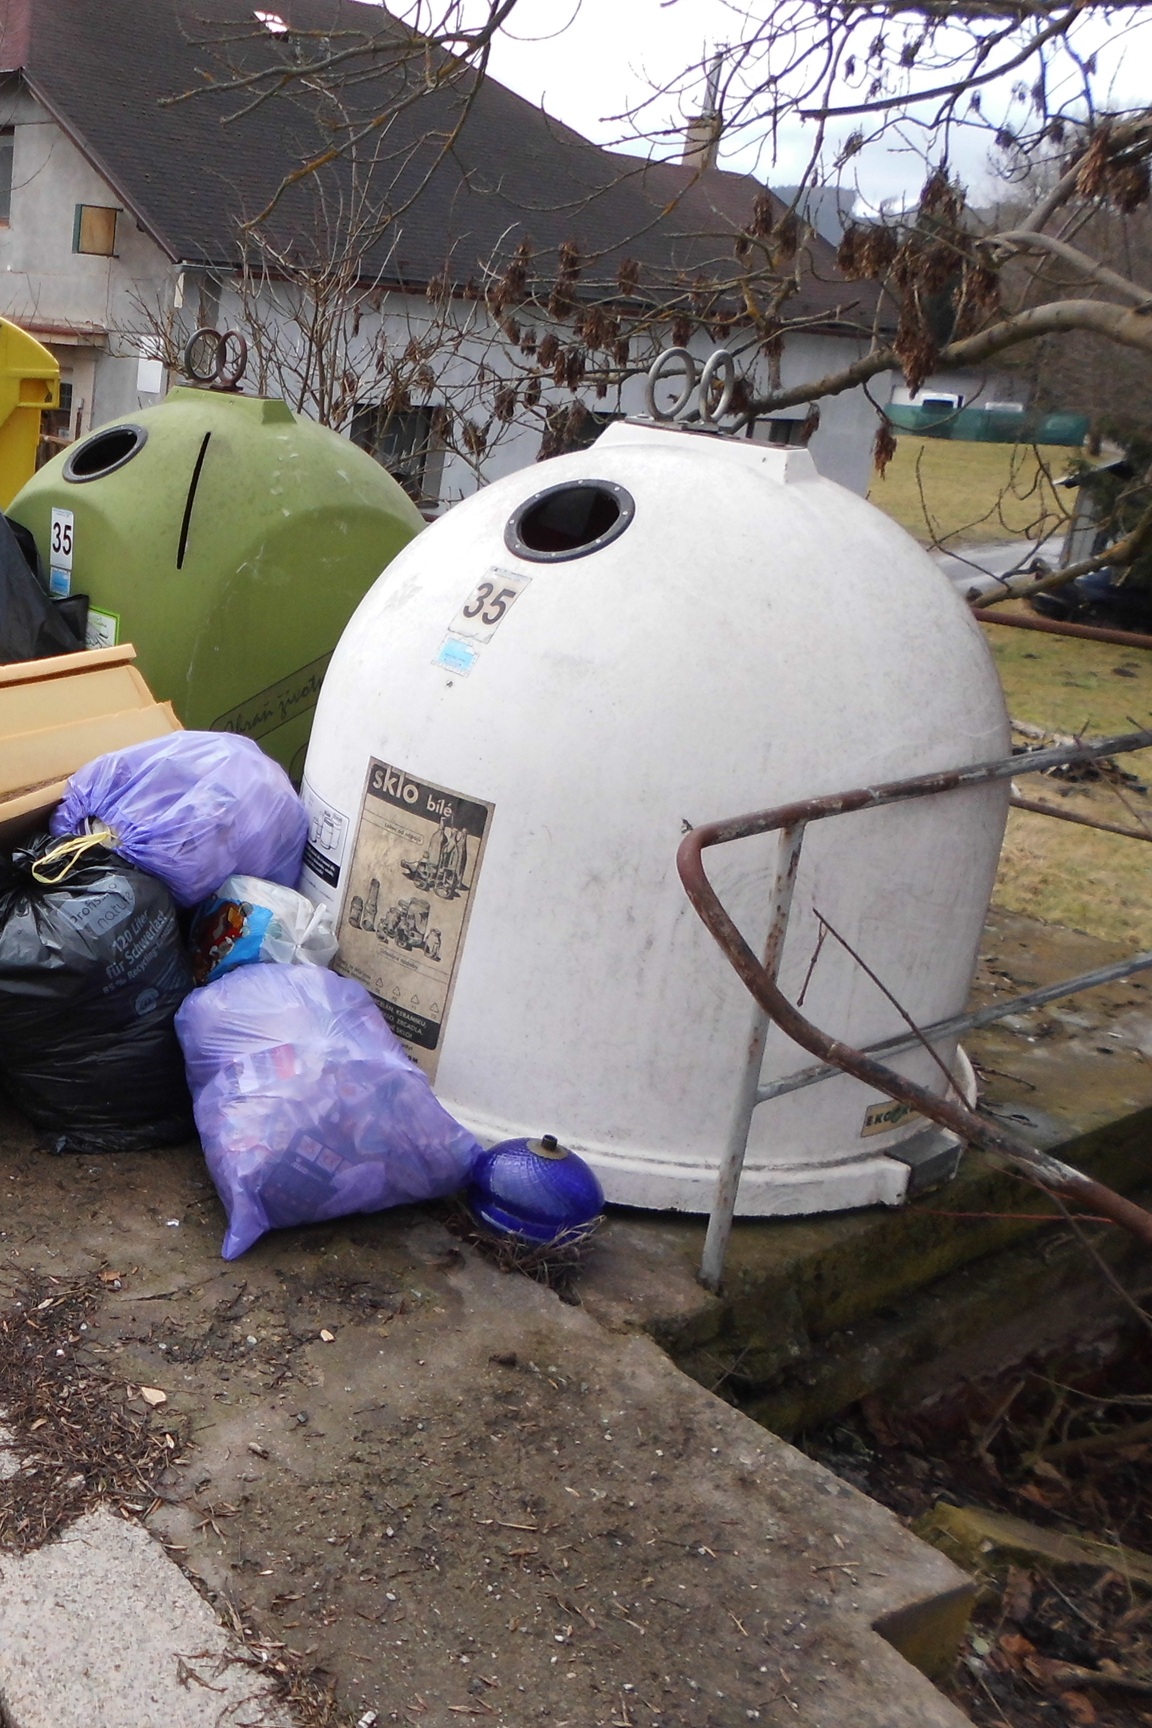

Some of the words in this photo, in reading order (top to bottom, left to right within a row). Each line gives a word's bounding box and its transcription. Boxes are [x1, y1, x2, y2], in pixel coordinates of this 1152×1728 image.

[52, 521, 72, 556] 35
[462, 582, 517, 625] 35
[372, 764, 419, 804] sklo
[426, 794, 453, 817] bílé
[105, 960, 126, 980] für
[124, 909, 168, 965] Schwerlast
[112, 929, 133, 952] 120
[130, 909, 148, 936] Liter
